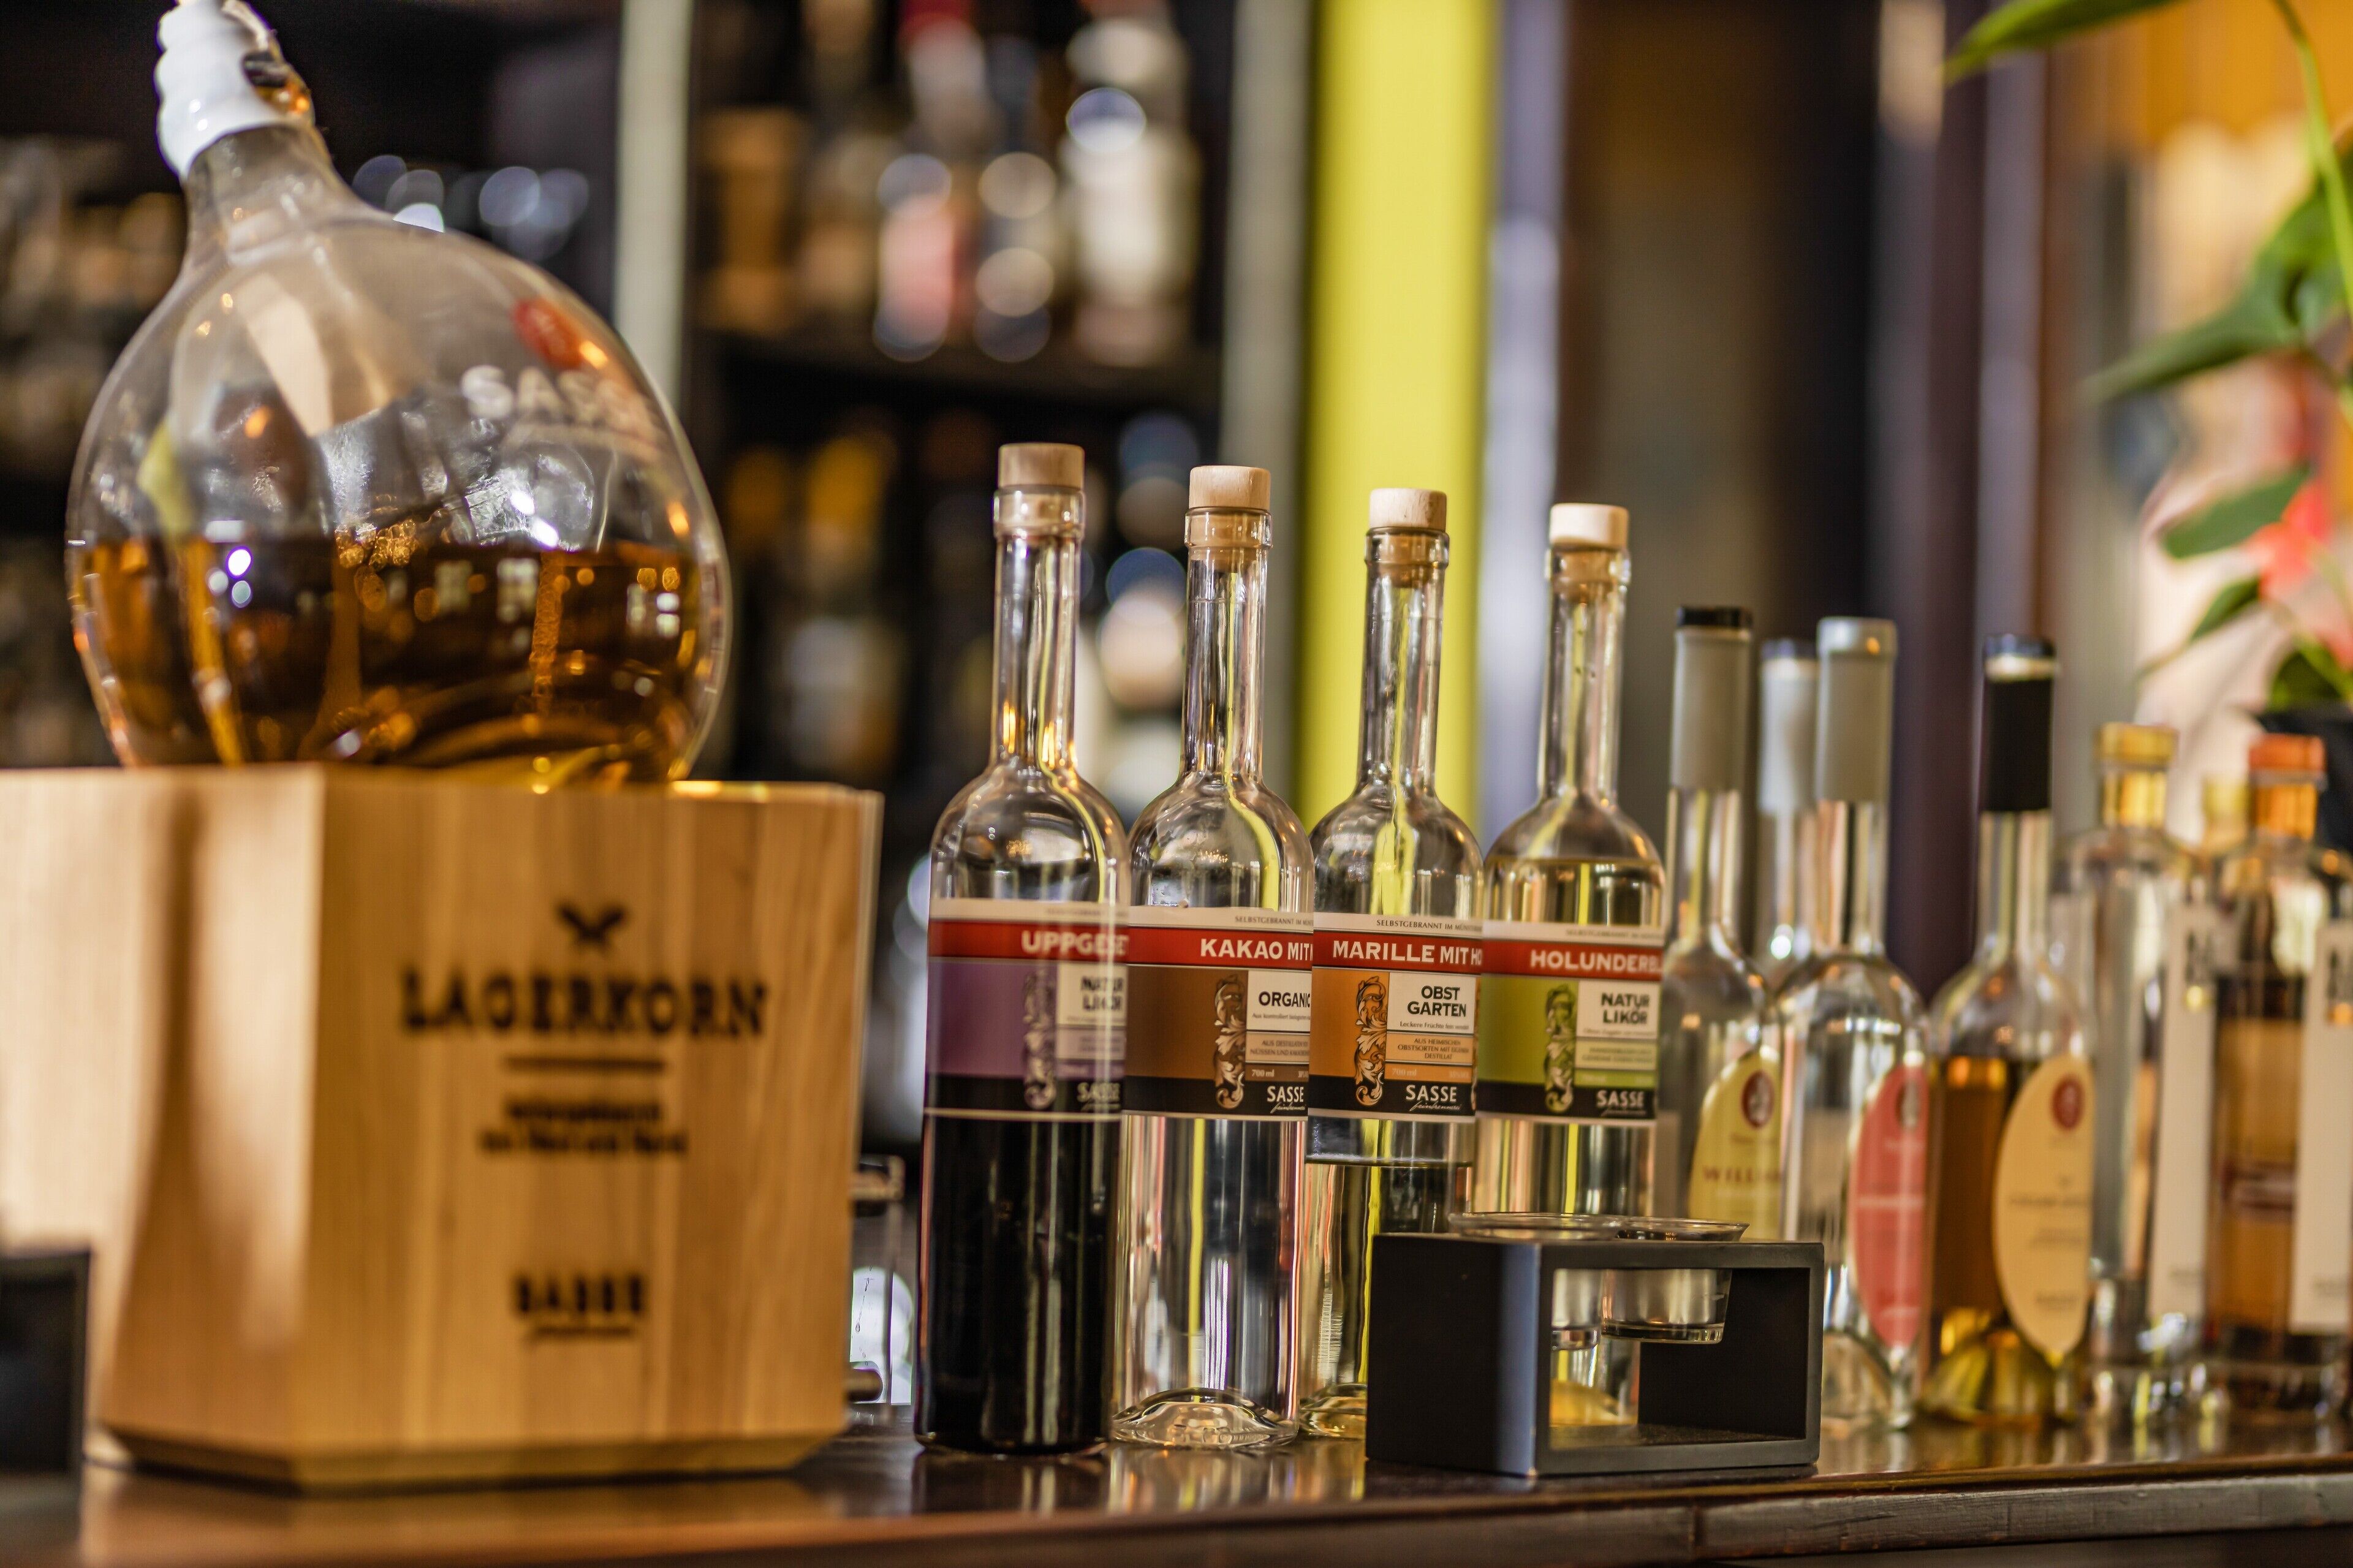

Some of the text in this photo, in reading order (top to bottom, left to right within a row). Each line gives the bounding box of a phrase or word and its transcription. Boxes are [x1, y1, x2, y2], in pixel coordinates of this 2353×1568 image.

[1376, 919, 1442, 930] SELBSTGEBRANNT
[1200, 938, 1283, 960] KAKAO
[1287, 942, 1309, 961] MIT
[1333, 941, 1435, 963] MARILLE
[1440, 945, 1469, 964] MIT
[1258, 991, 1311, 1008] ORGANIC
[1421, 985, 1460, 1001] OBST
[1601, 992, 1650, 1007] NATUR
[1407, 1001, 1466, 1017] GARTEN
[1267, 1085, 1304, 1102] SASSE
[1406, 1085, 1457, 1102] SASSE
[1597, 1089, 1645, 1108] SASSE
